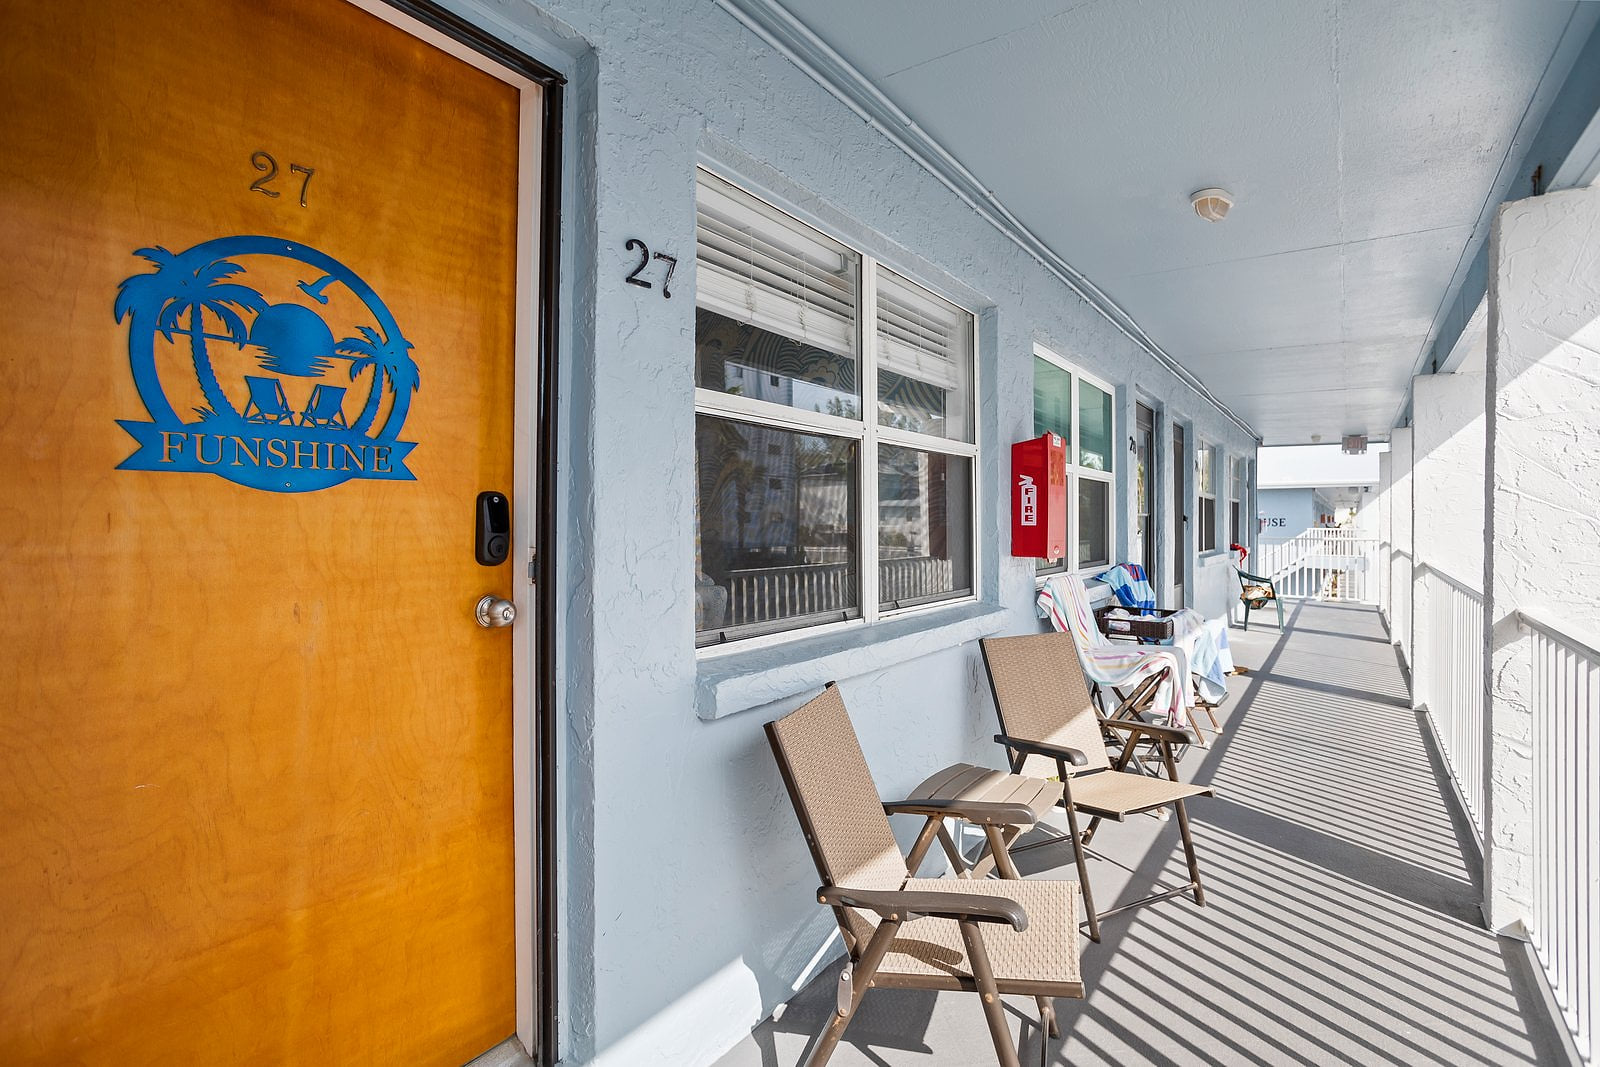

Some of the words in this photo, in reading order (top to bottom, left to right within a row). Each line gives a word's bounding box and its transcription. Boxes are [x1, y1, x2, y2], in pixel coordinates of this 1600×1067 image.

[250, 151, 314, 208] 27
[625, 238, 677, 299] 27
[158, 431, 393, 473] FUNSHINE
[1024, 487, 1034, 523] FIRE
